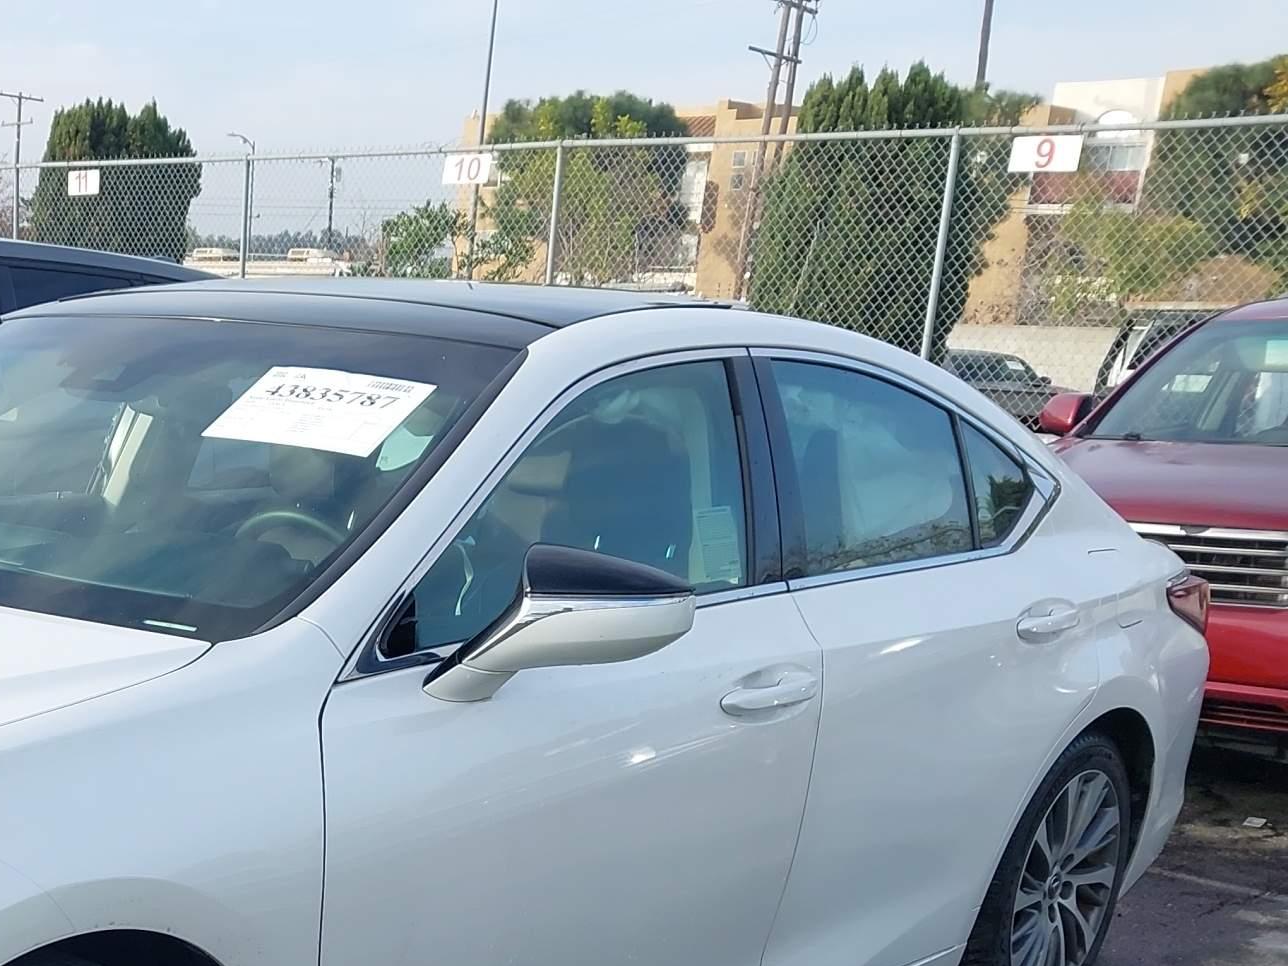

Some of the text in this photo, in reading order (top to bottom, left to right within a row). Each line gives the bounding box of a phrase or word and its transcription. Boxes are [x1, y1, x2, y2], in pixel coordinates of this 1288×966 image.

[1035, 138, 1056, 168] 9
[75, 170, 88, 193] 11
[455, 156, 481, 181] 10
[265, 382, 400, 409] 43835787
